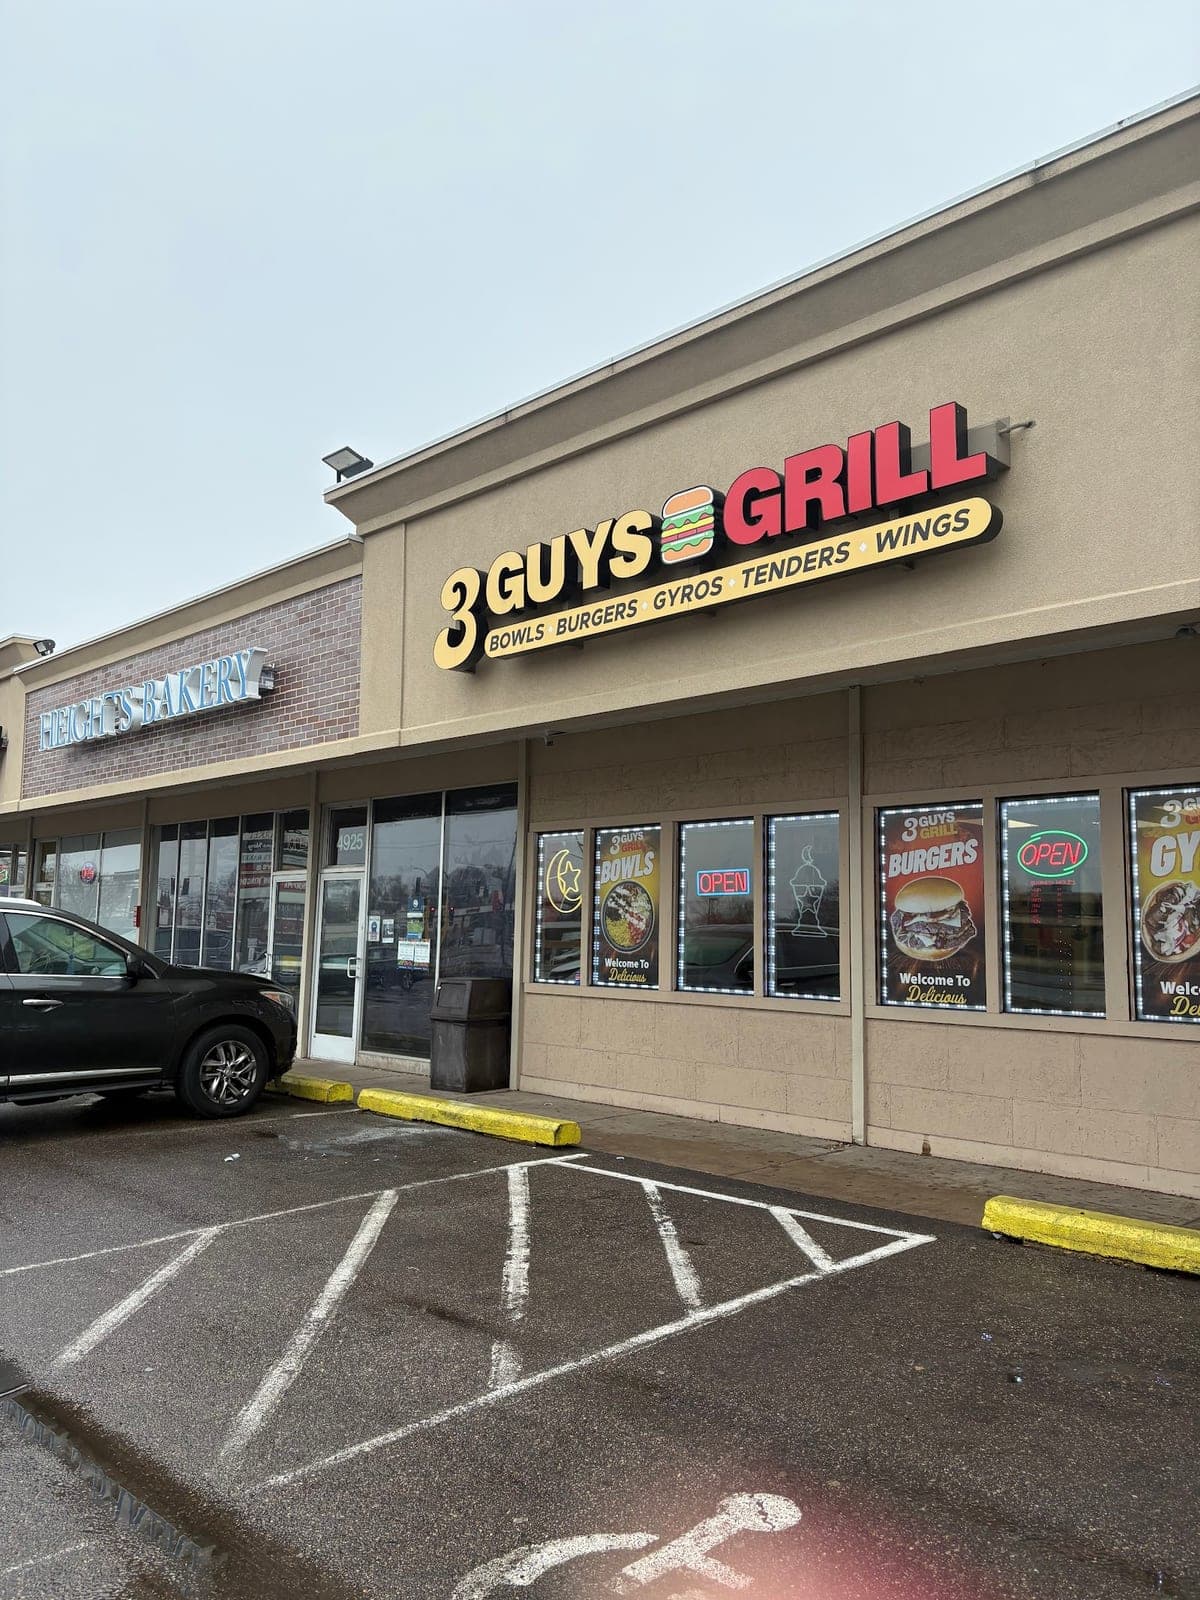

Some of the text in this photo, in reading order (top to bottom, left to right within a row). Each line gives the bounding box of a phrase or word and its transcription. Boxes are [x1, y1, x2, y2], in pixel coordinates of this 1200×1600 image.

[433, 401, 987, 670] 3 GUYS GRILL
[489, 508, 970, 652] BOWLS BURGERS GYROS TENDERS WINGS
[141, 648, 259, 726] BAKERY
[1160, 799, 1182, 829] 3
[902, 811, 956, 842] 3 GUYS
[920, 823, 958, 840] GRILL
[336, 833, 363, 850] 4925
[610, 831, 644, 855] 3 GUYS
[888, 838, 979, 878] BURGERS
[1021, 842, 1081, 866] OPEN
[600, 850, 655, 885] BOWLS
[700, 871, 748, 893] OPEN
[604, 957, 650, 969] Welcome To
[608, 967, 647, 983] Delicious
[899, 972, 971, 987] Welcome To
[906, 985, 967, 1004] Delicious
[1160, 981, 1200, 996] Welc
[1170, 995, 1200, 1016] De
